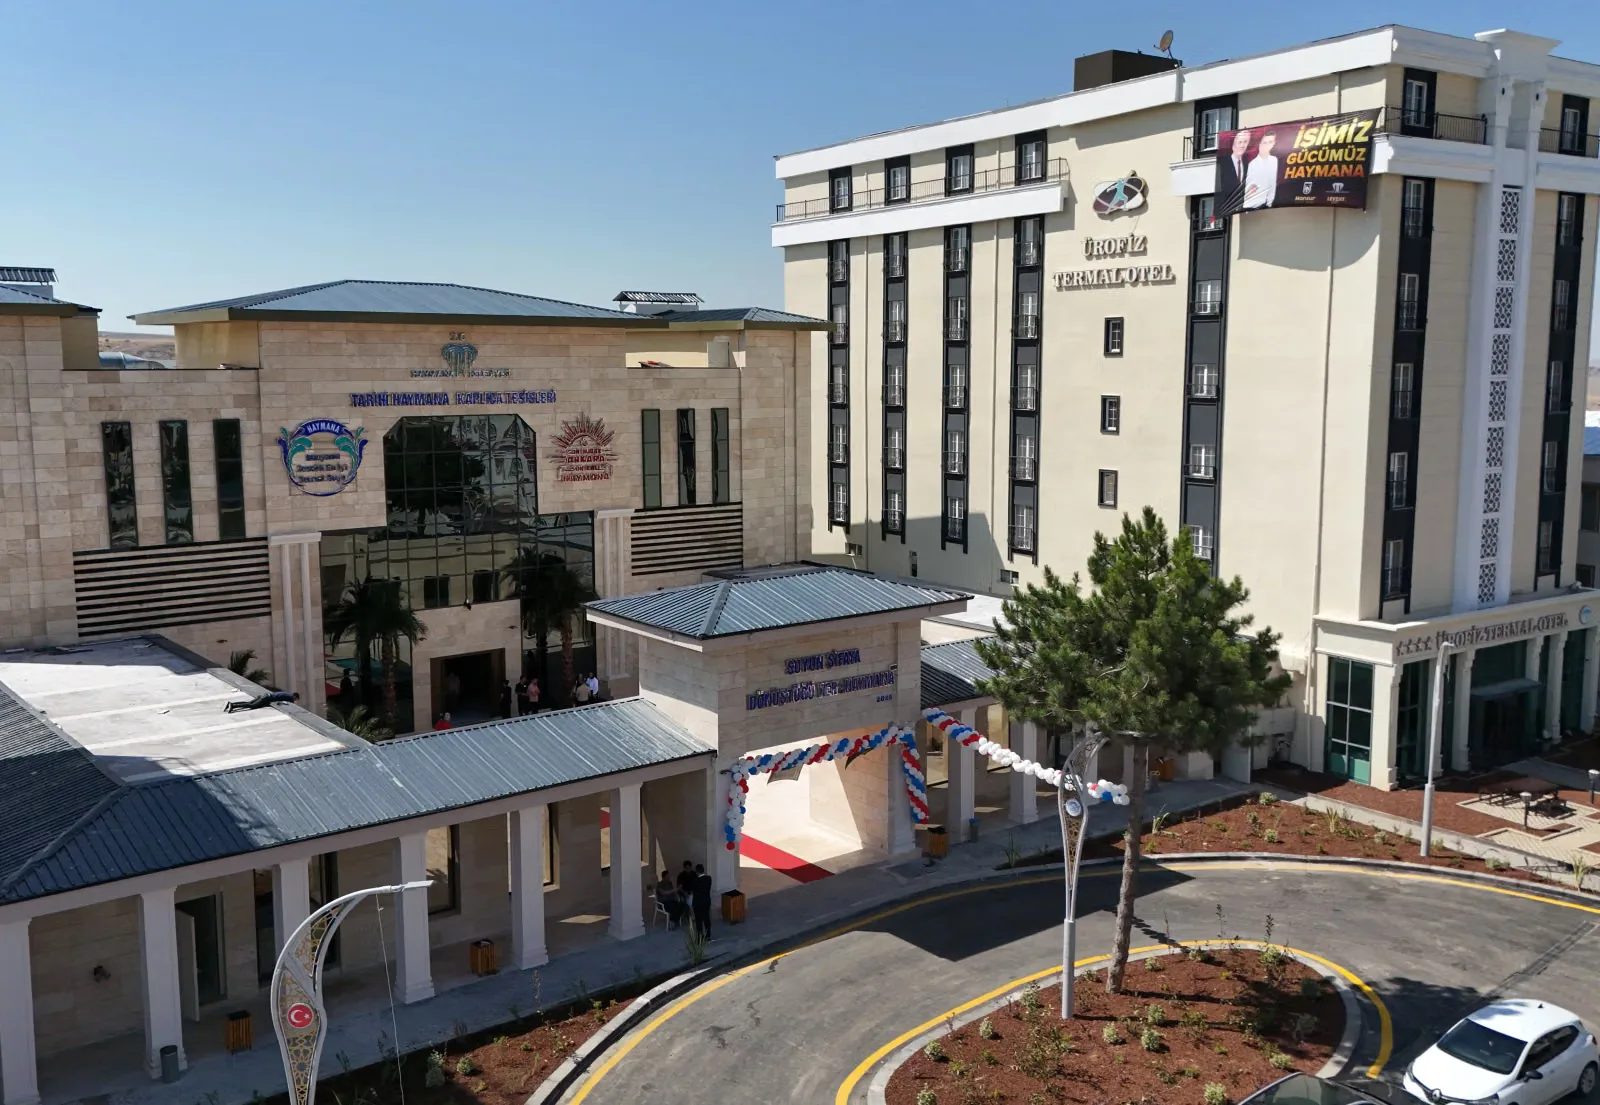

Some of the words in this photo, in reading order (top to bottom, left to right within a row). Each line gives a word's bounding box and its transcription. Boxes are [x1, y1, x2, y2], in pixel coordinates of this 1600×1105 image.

[1286, 145, 1367, 165] GÜCÜMÜZ
[1284, 164, 1365, 179] HAYMANA
[1082, 233, 1147, 257] ÜROFİZ
[1053, 267, 1124, 289] TERMAL
[1125, 264, 1175, 285] OTEL
[391, 391, 450, 406] HAYMANA
[456, 391, 503, 405] KAPLICA
[306, 421, 341, 434] HAYMANA
[565, 455, 605, 464] ANKARA
